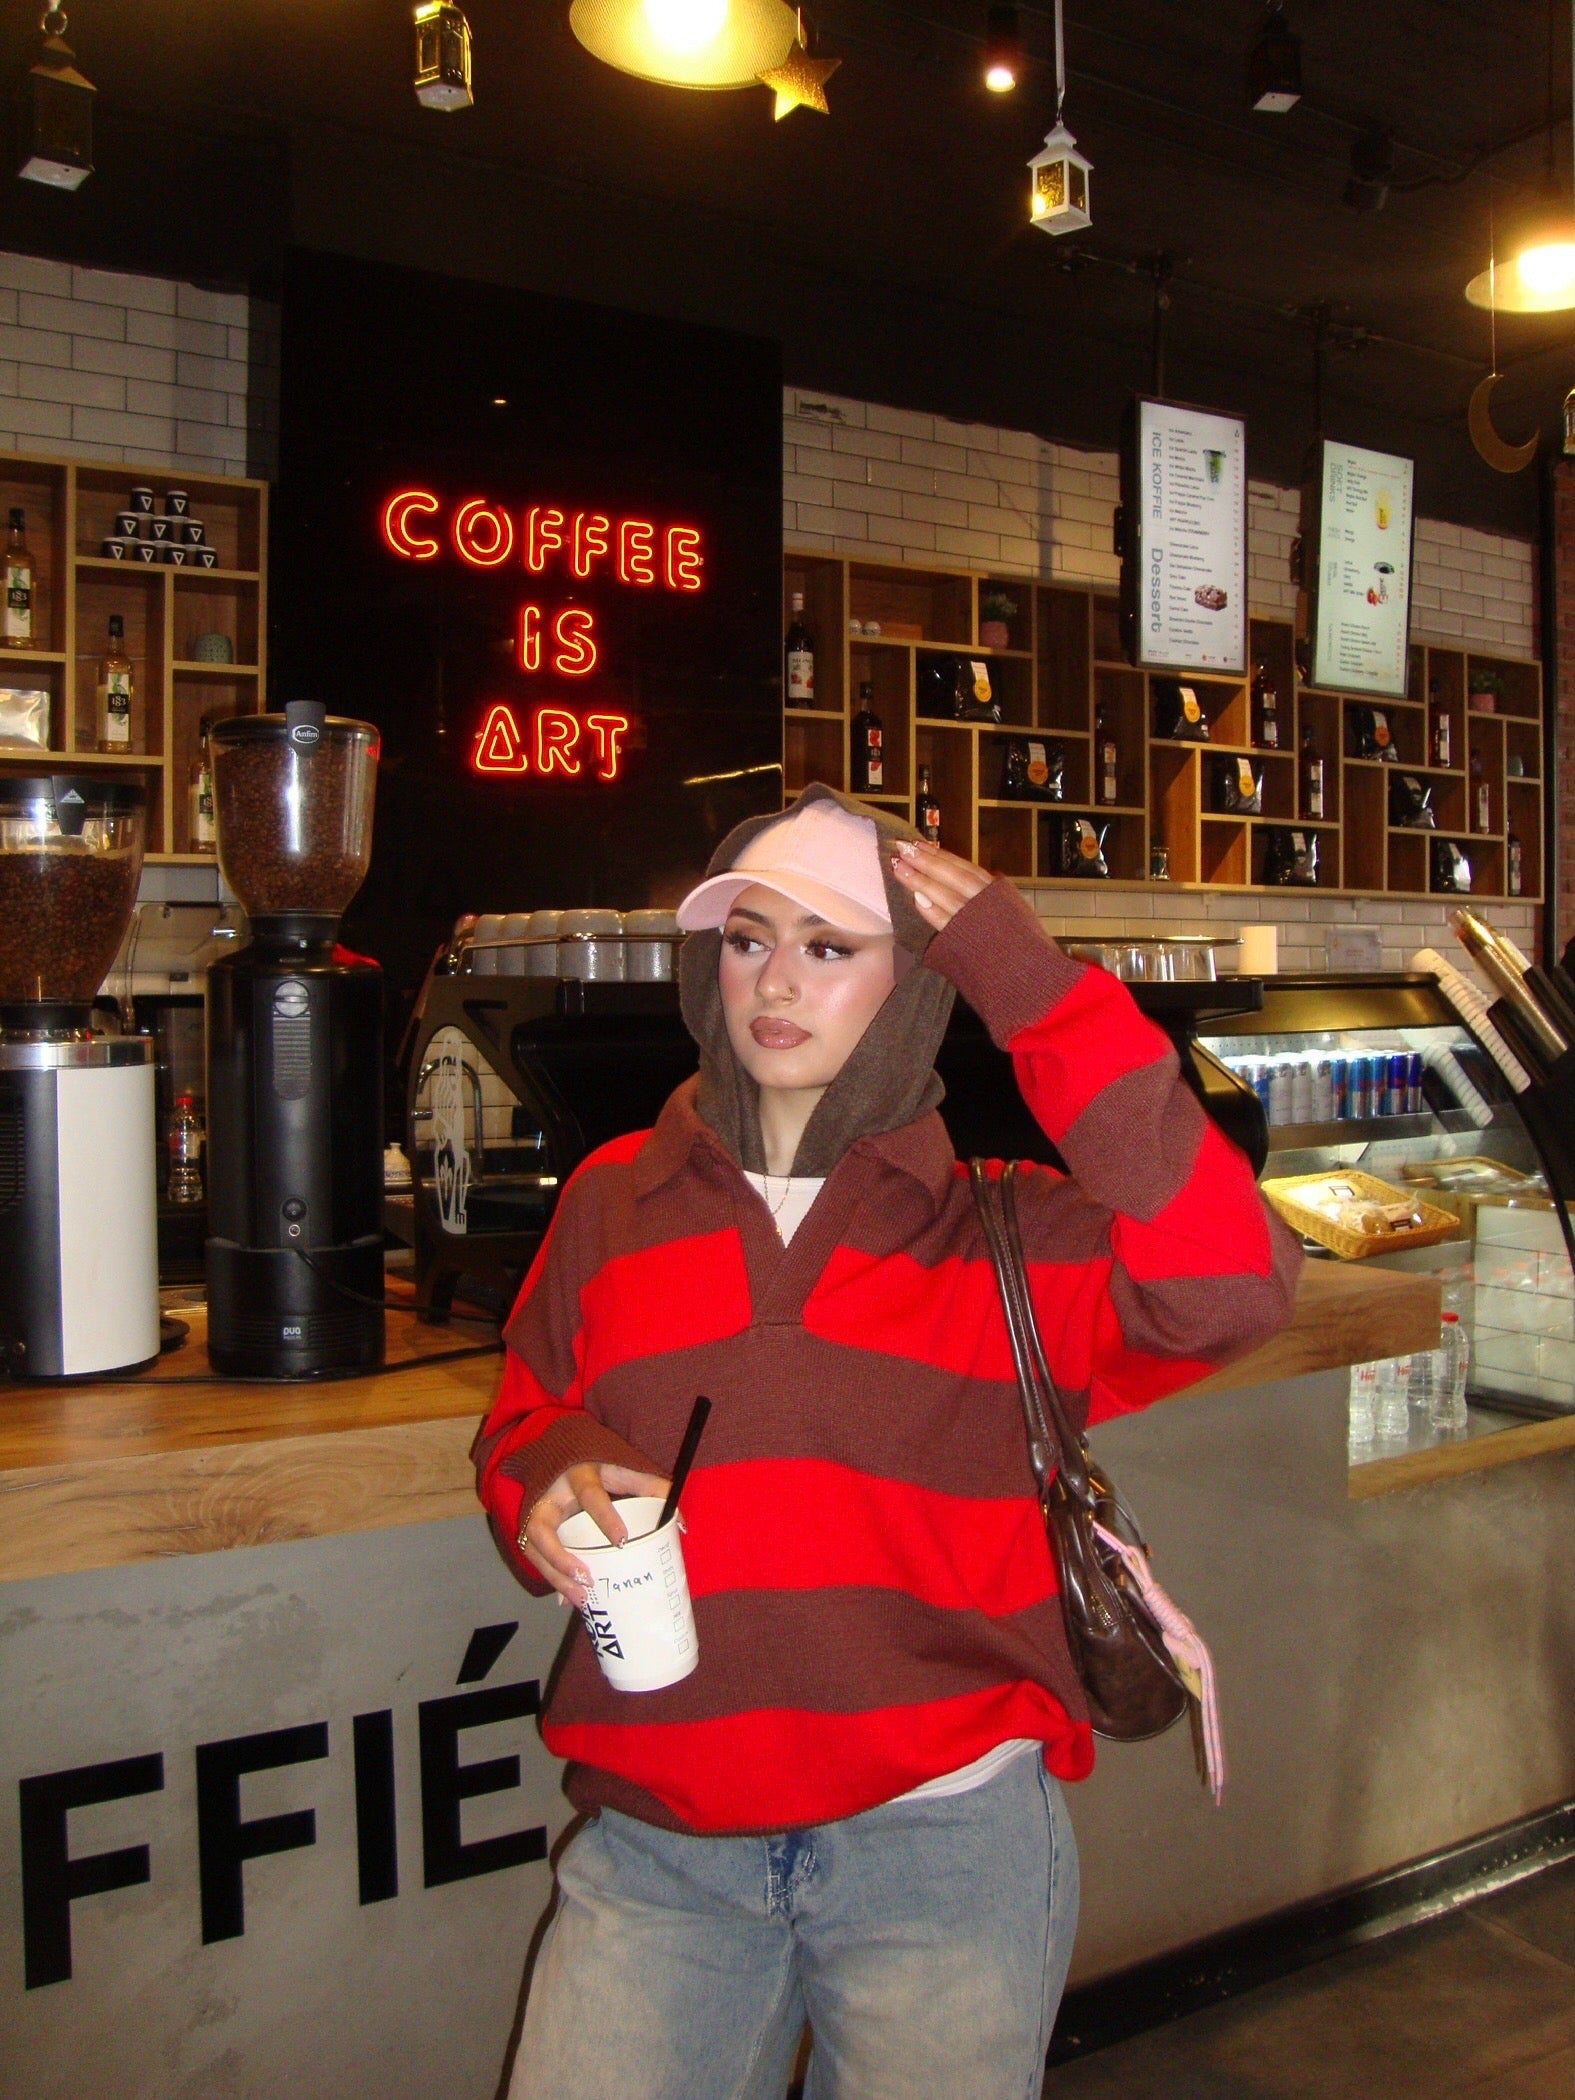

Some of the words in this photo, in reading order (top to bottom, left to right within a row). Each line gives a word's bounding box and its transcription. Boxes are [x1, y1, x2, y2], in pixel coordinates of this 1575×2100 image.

[1152, 432, 1162, 458] ICE
[384, 489, 703, 591] COFFEE
[1151, 548, 1163, 633] Dessert
[474, 704, 629, 779] ART
[587, 1602, 625, 1660] ART
